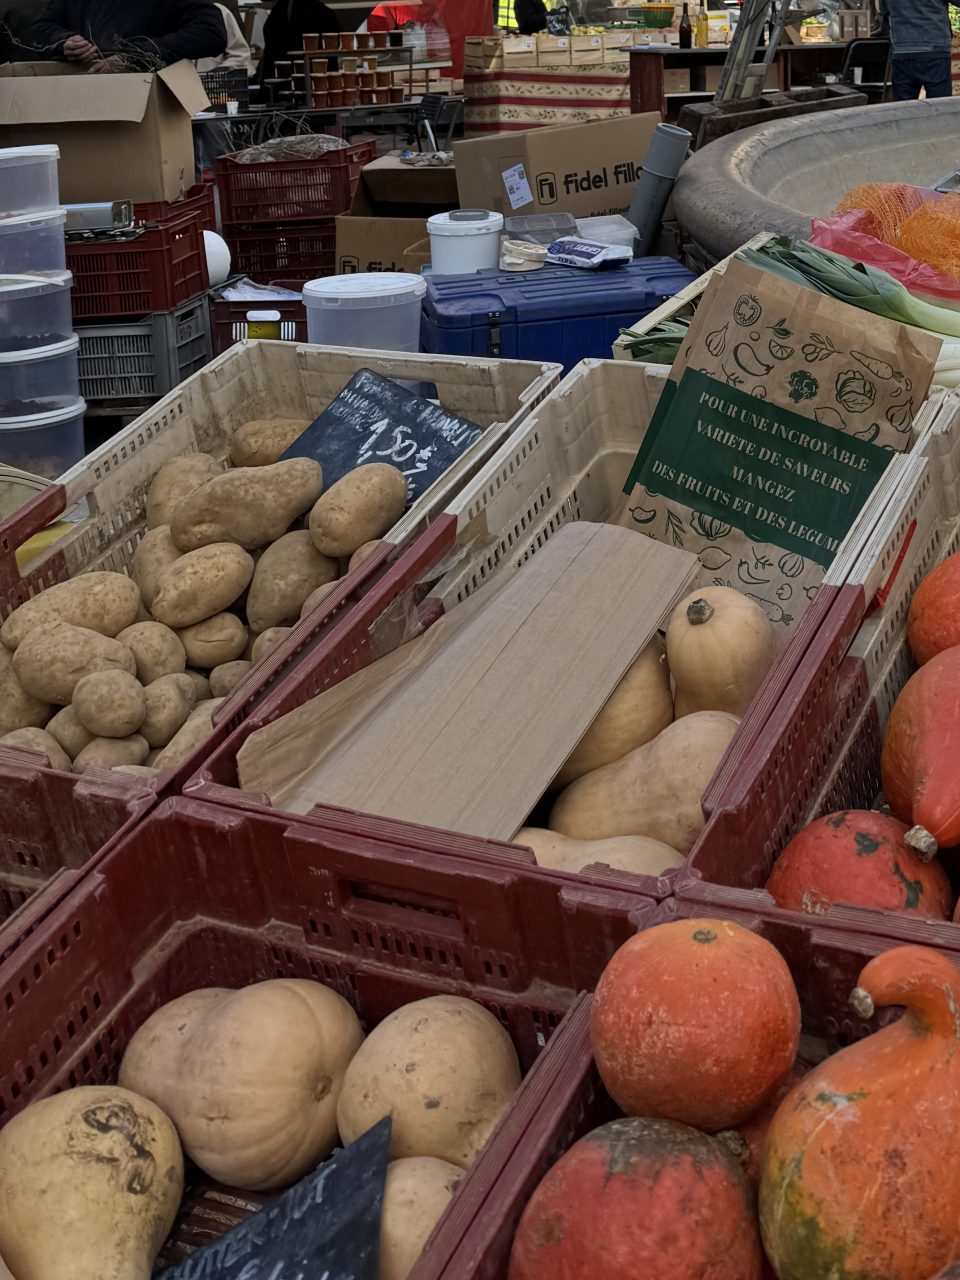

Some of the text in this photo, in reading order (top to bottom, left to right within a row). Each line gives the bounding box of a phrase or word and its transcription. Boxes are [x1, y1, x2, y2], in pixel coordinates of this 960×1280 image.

[563, 167, 609, 195] fidel
[697, 419, 852, 495] VARIETE DE SAVEURS
[698, 391, 869, 472] POUR UNE INCROYABLE
[652, 460, 840, 552] DES FRUITS ET DES LEGUM
[730, 466, 797, 503] MANGEZ
